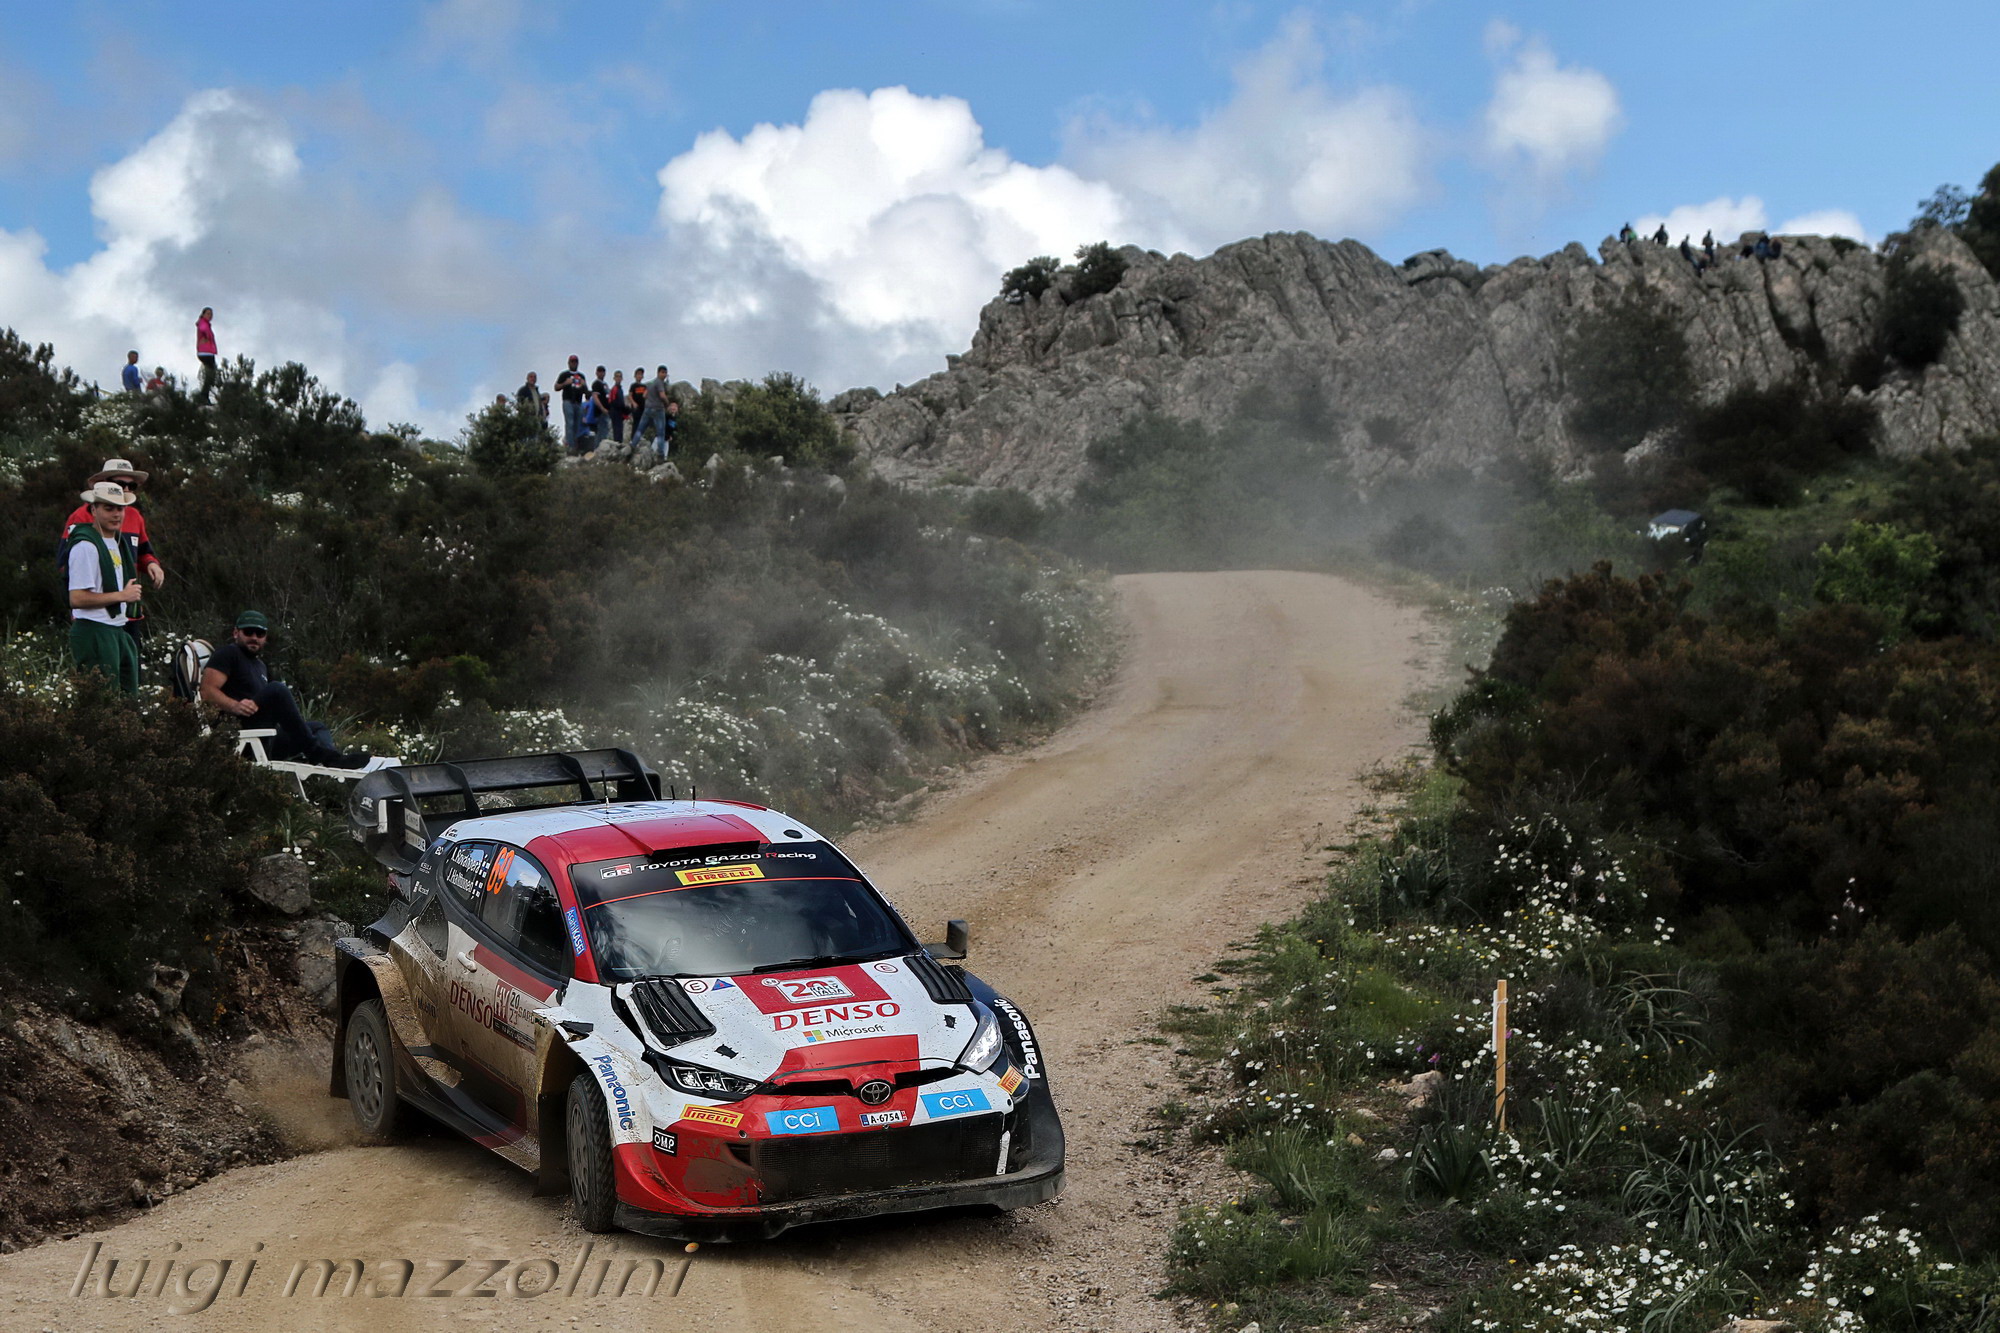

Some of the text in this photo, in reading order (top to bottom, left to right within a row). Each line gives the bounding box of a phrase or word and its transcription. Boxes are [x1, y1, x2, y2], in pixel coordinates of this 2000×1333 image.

[487, 846, 515, 895] 69
[636, 858, 701, 872] TOYOTA
[705, 853, 762, 865] GAZOO
[766, 852, 817, 860] Racing
[684, 866, 755, 882] PIRELLI
[450, 980, 493, 1029] DENSO
[773, 1002, 901, 1032] DENSO
[826, 1023, 886, 1038] Microsoft
[994, 998, 1041, 1079] Panasonic
[684, 1106, 739, 1125] PIRELLI
[870, 1112, 900, 1123] A-6754
[654, 1133, 675, 1150] OMP
